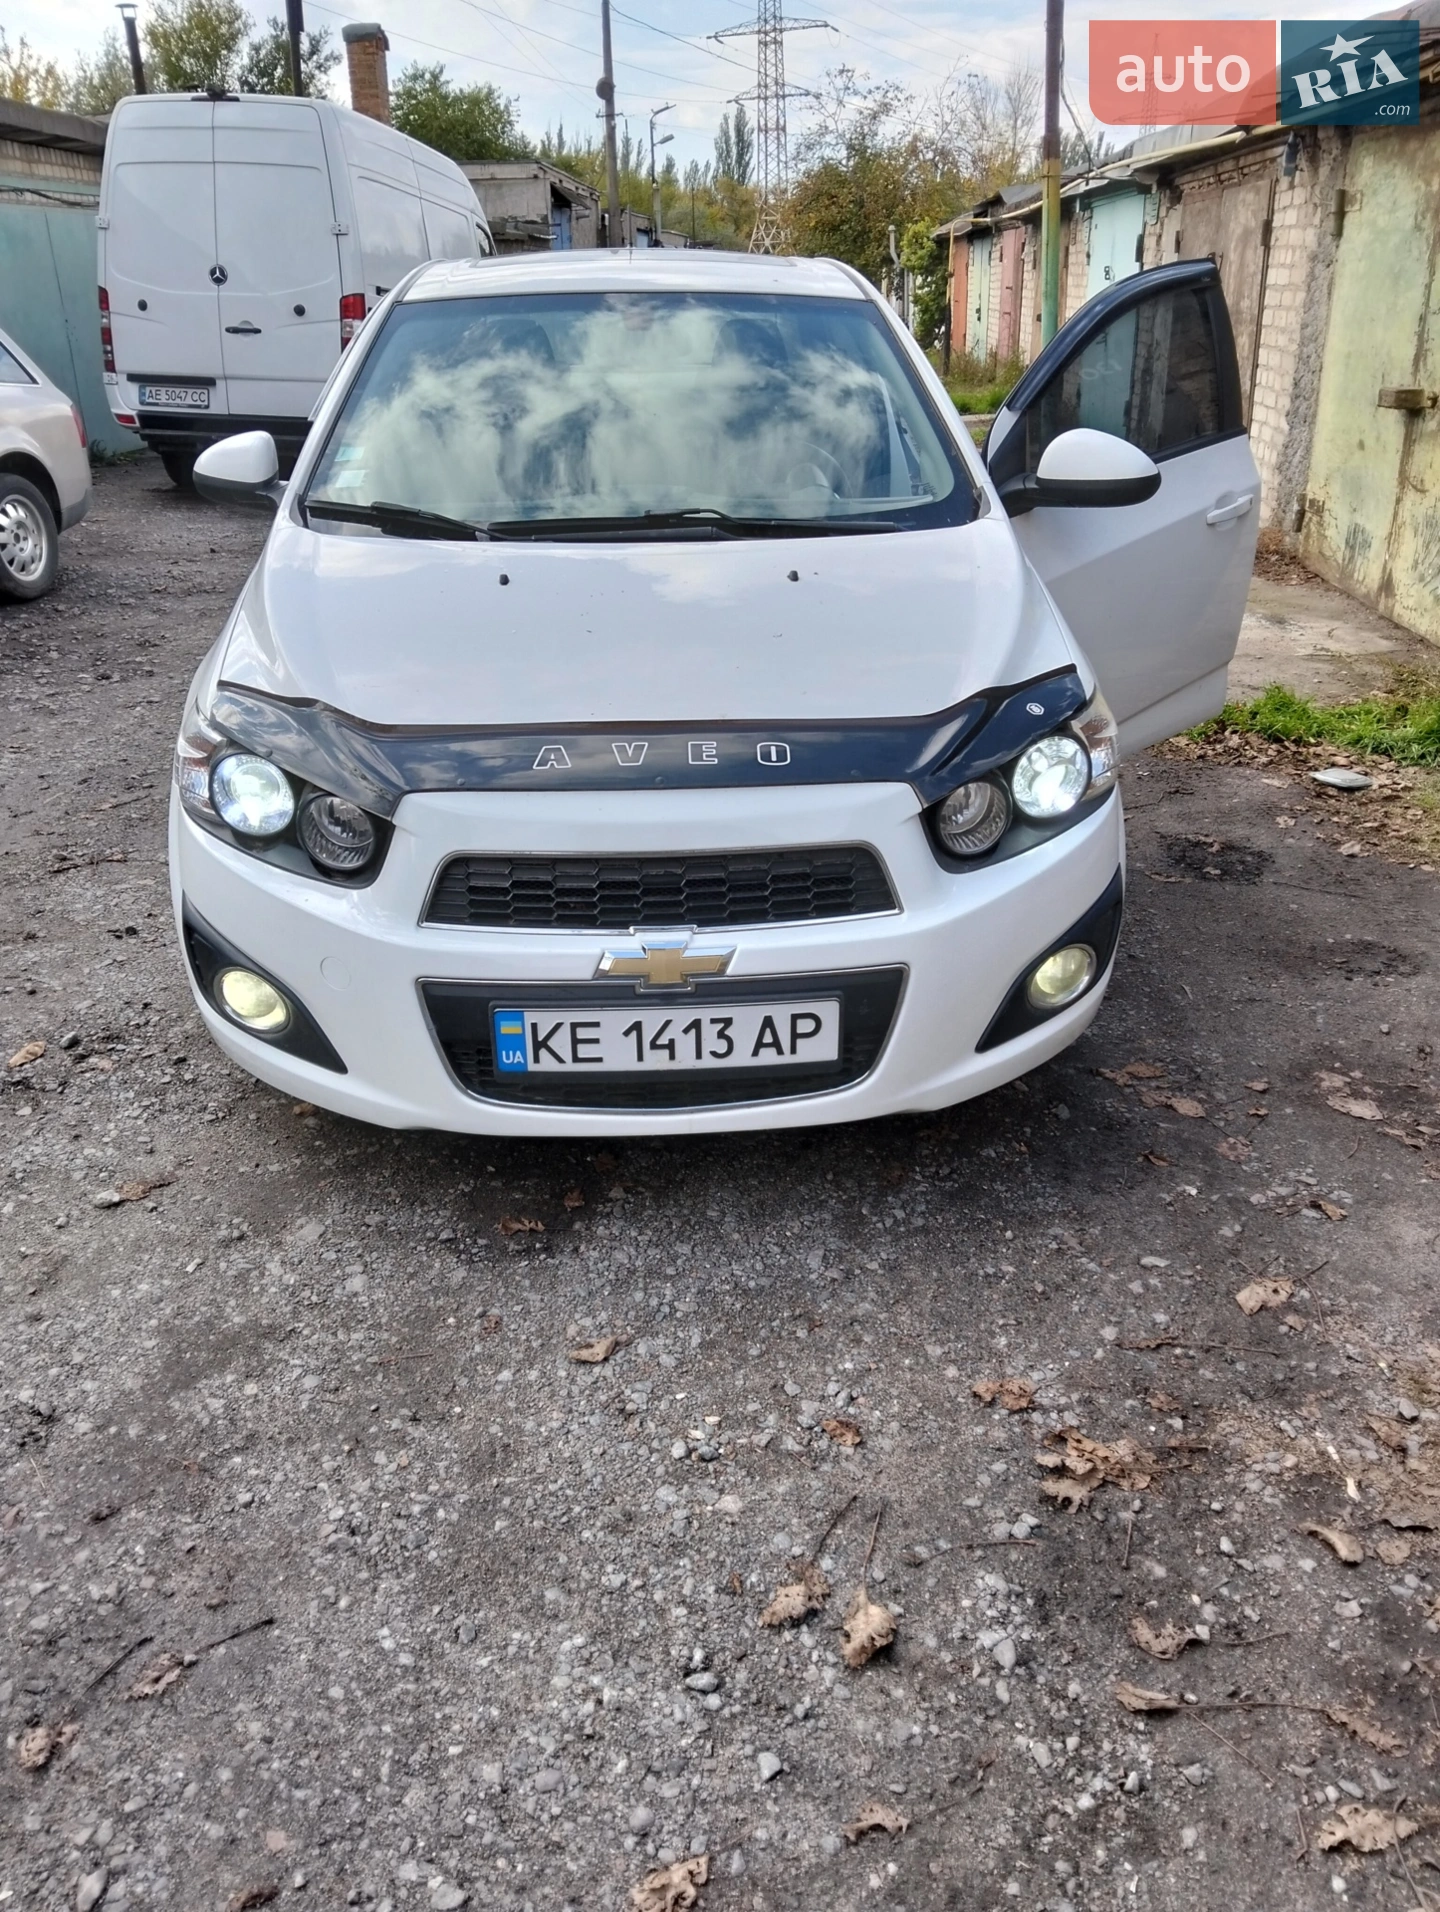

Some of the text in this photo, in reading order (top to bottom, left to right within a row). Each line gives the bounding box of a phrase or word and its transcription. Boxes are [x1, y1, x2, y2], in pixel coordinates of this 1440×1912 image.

[1104, 265, 1111, 280] 8
[147, 389, 206, 403] AE 5047 CC
[532, 741, 791, 770] AVEO
[530, 1011, 823, 1065] KE 1413 AP
[502, 1050, 525, 1065] UA
